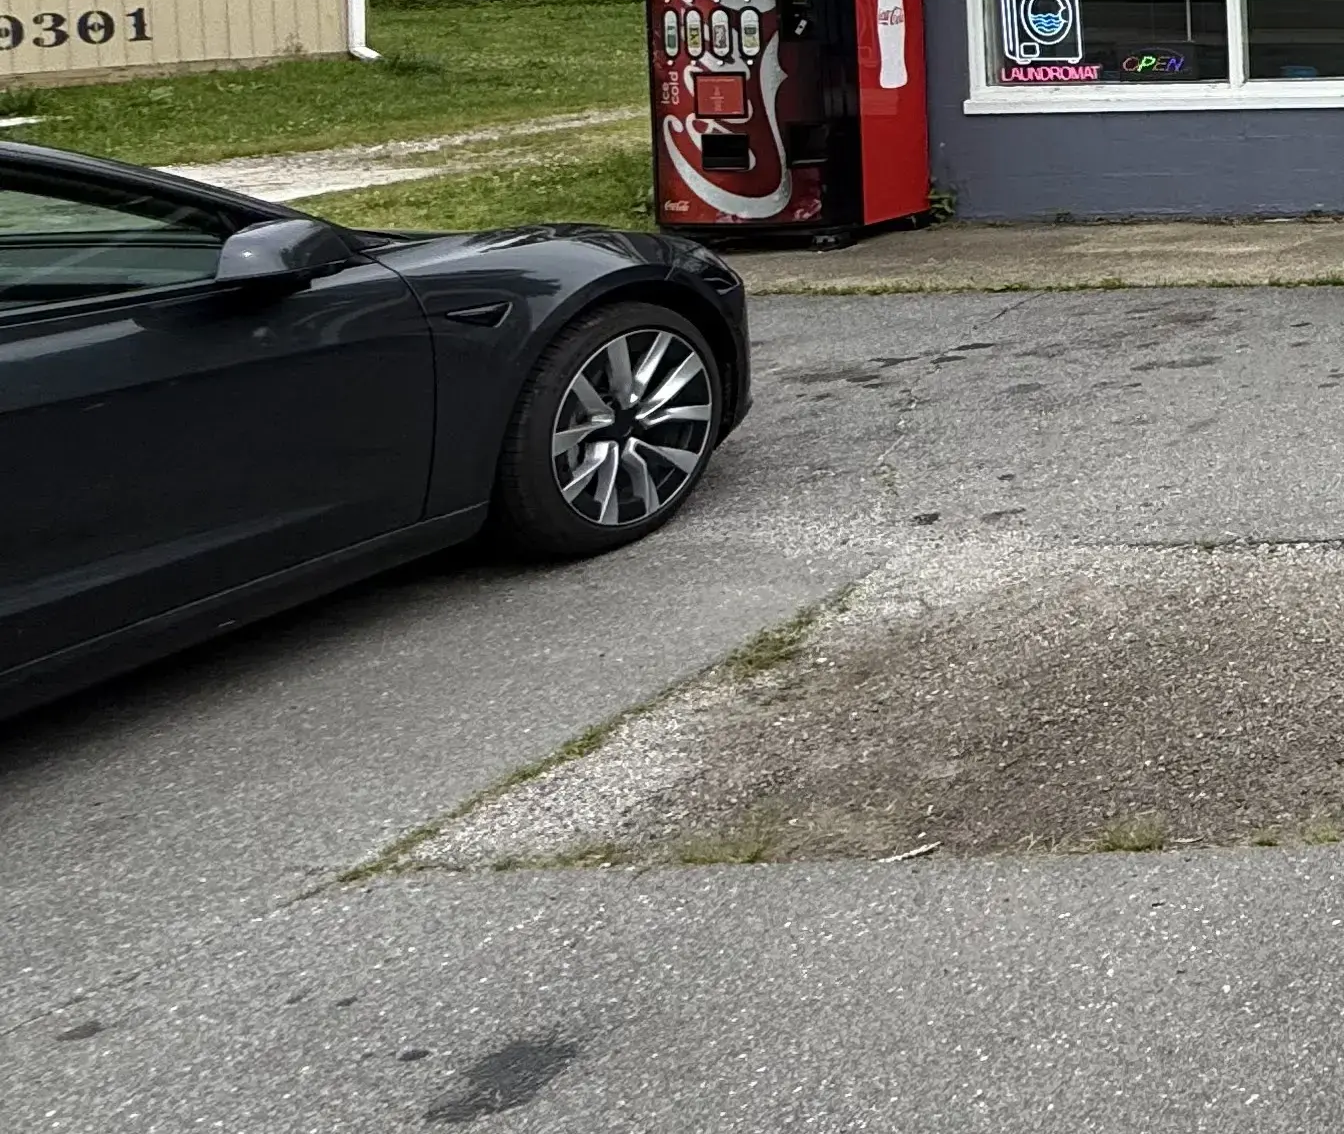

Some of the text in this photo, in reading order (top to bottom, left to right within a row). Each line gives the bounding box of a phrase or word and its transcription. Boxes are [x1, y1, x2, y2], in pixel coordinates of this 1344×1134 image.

[1122, 56, 1185, 73] OPEN
[1002, 66, 1101, 82] LAUNDROMAT
[668, 71, 680, 106] cold
